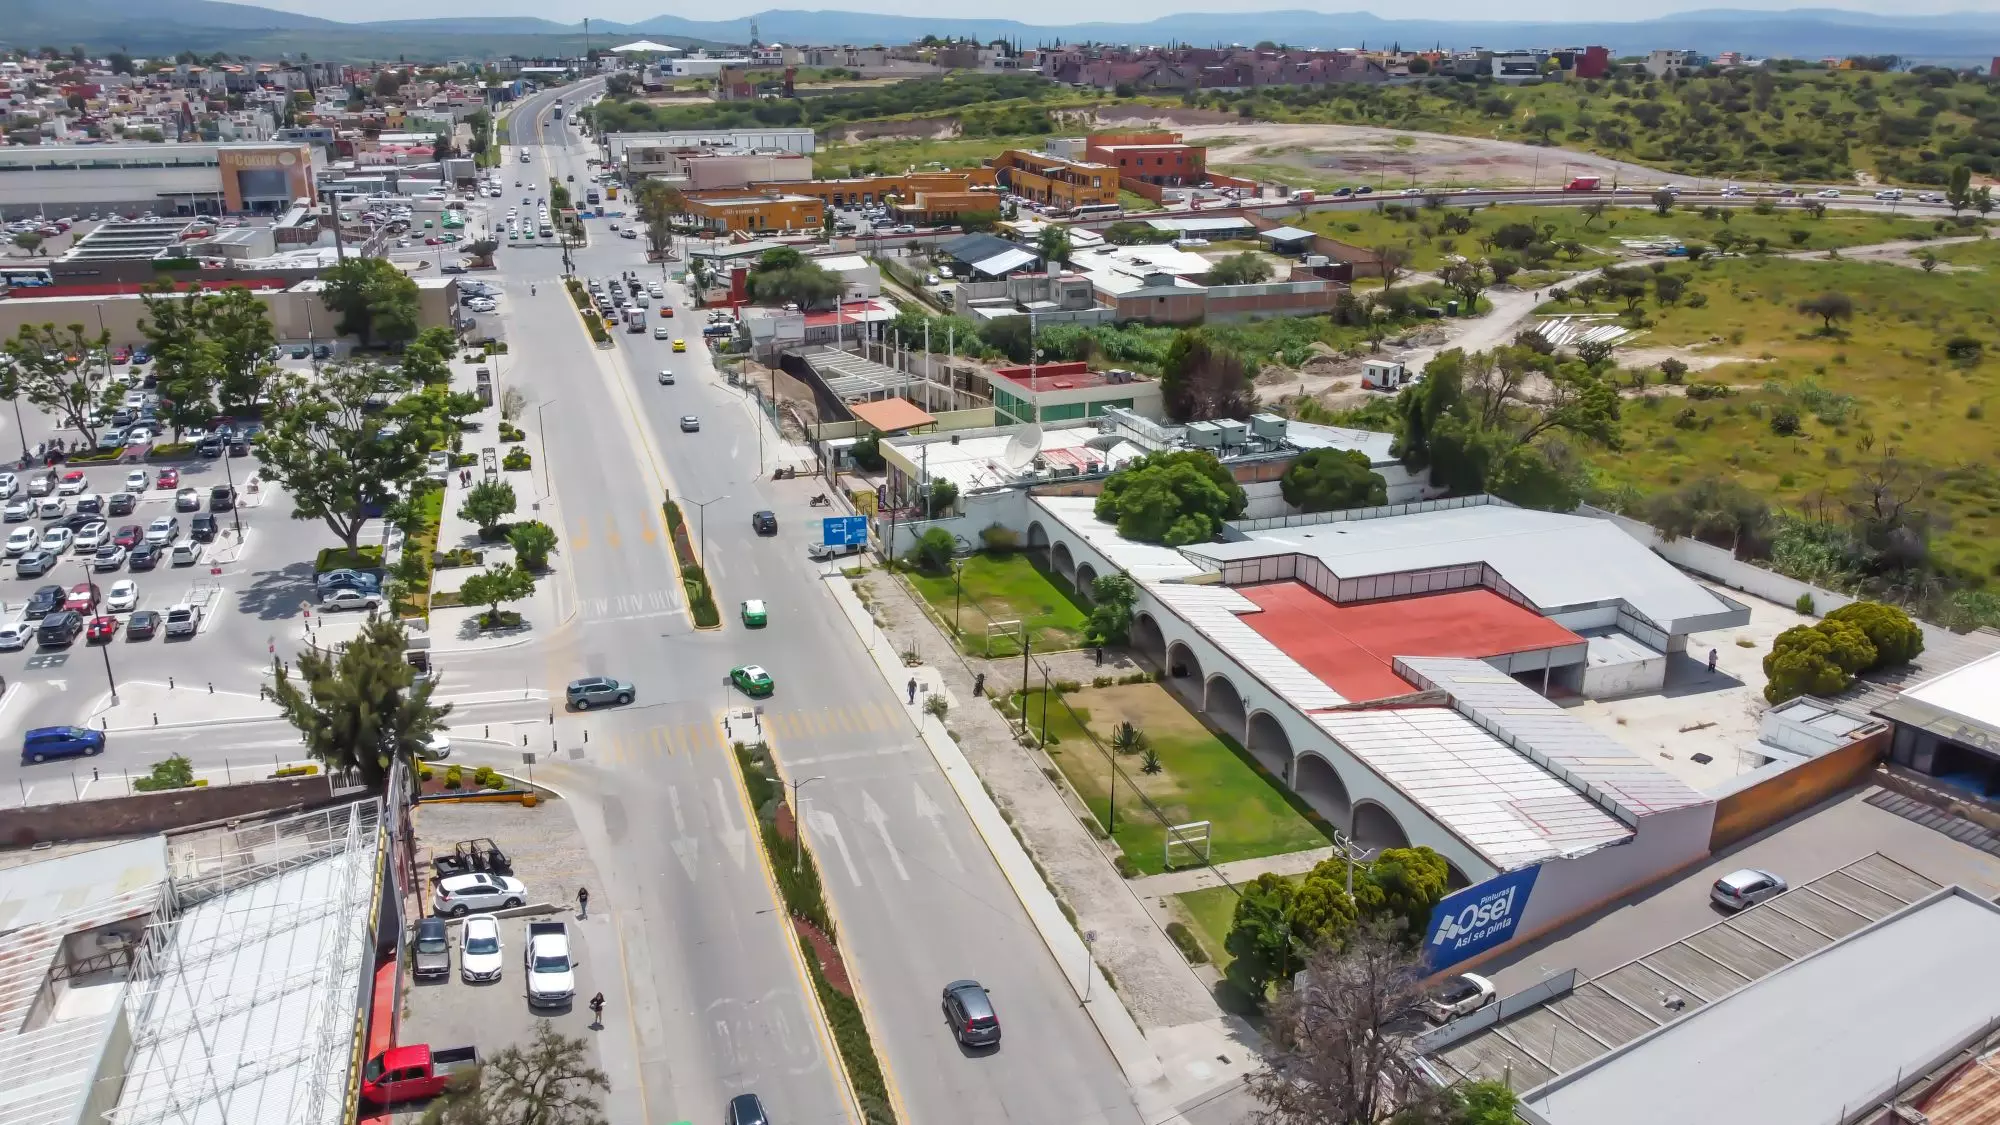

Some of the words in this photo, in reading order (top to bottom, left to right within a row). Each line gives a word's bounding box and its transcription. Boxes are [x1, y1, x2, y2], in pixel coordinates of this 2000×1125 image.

[1480, 888, 1510, 905] Pinturas
[1458, 885, 1516, 935] Osel
[1473, 929, 1485, 941] se
[1486, 917, 1512, 937] pinta
